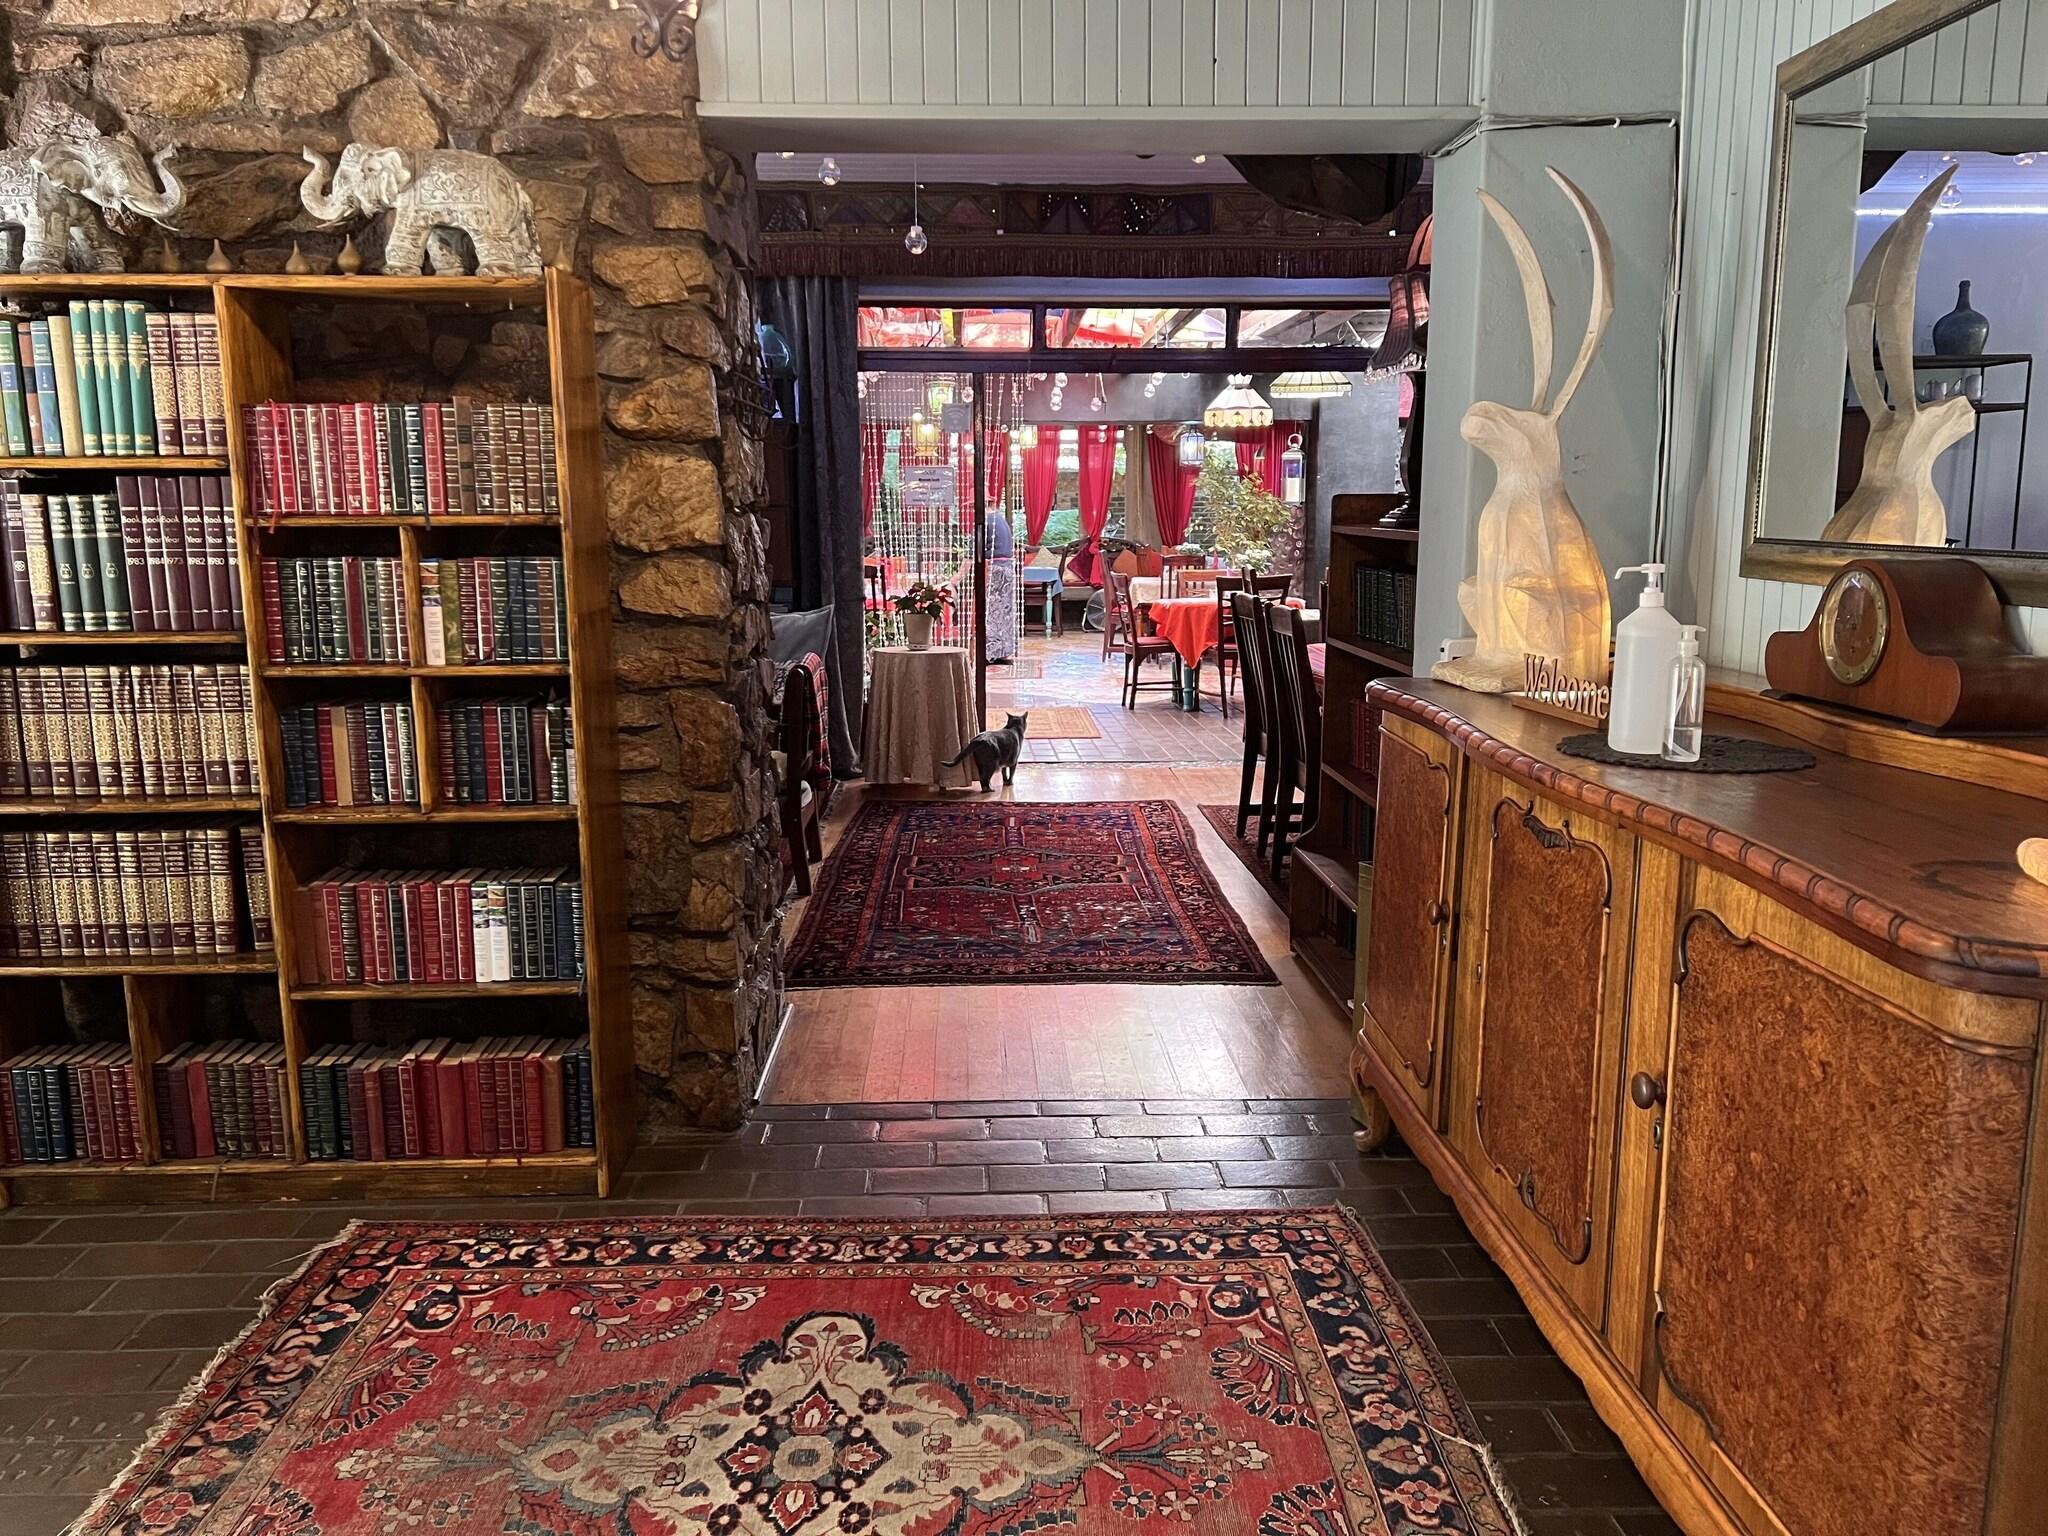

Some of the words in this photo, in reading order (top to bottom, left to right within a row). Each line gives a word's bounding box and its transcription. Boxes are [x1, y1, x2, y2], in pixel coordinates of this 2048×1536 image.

[121, 514, 141, 523] Book
[183, 514, 202, 523] Book
[203, 514, 223, 523] Book
[124, 535, 141, 544] Year
[185, 535, 203, 544] Year
[206, 535, 223, 544] Year
[1524, 653, 1610, 720] Welcome
